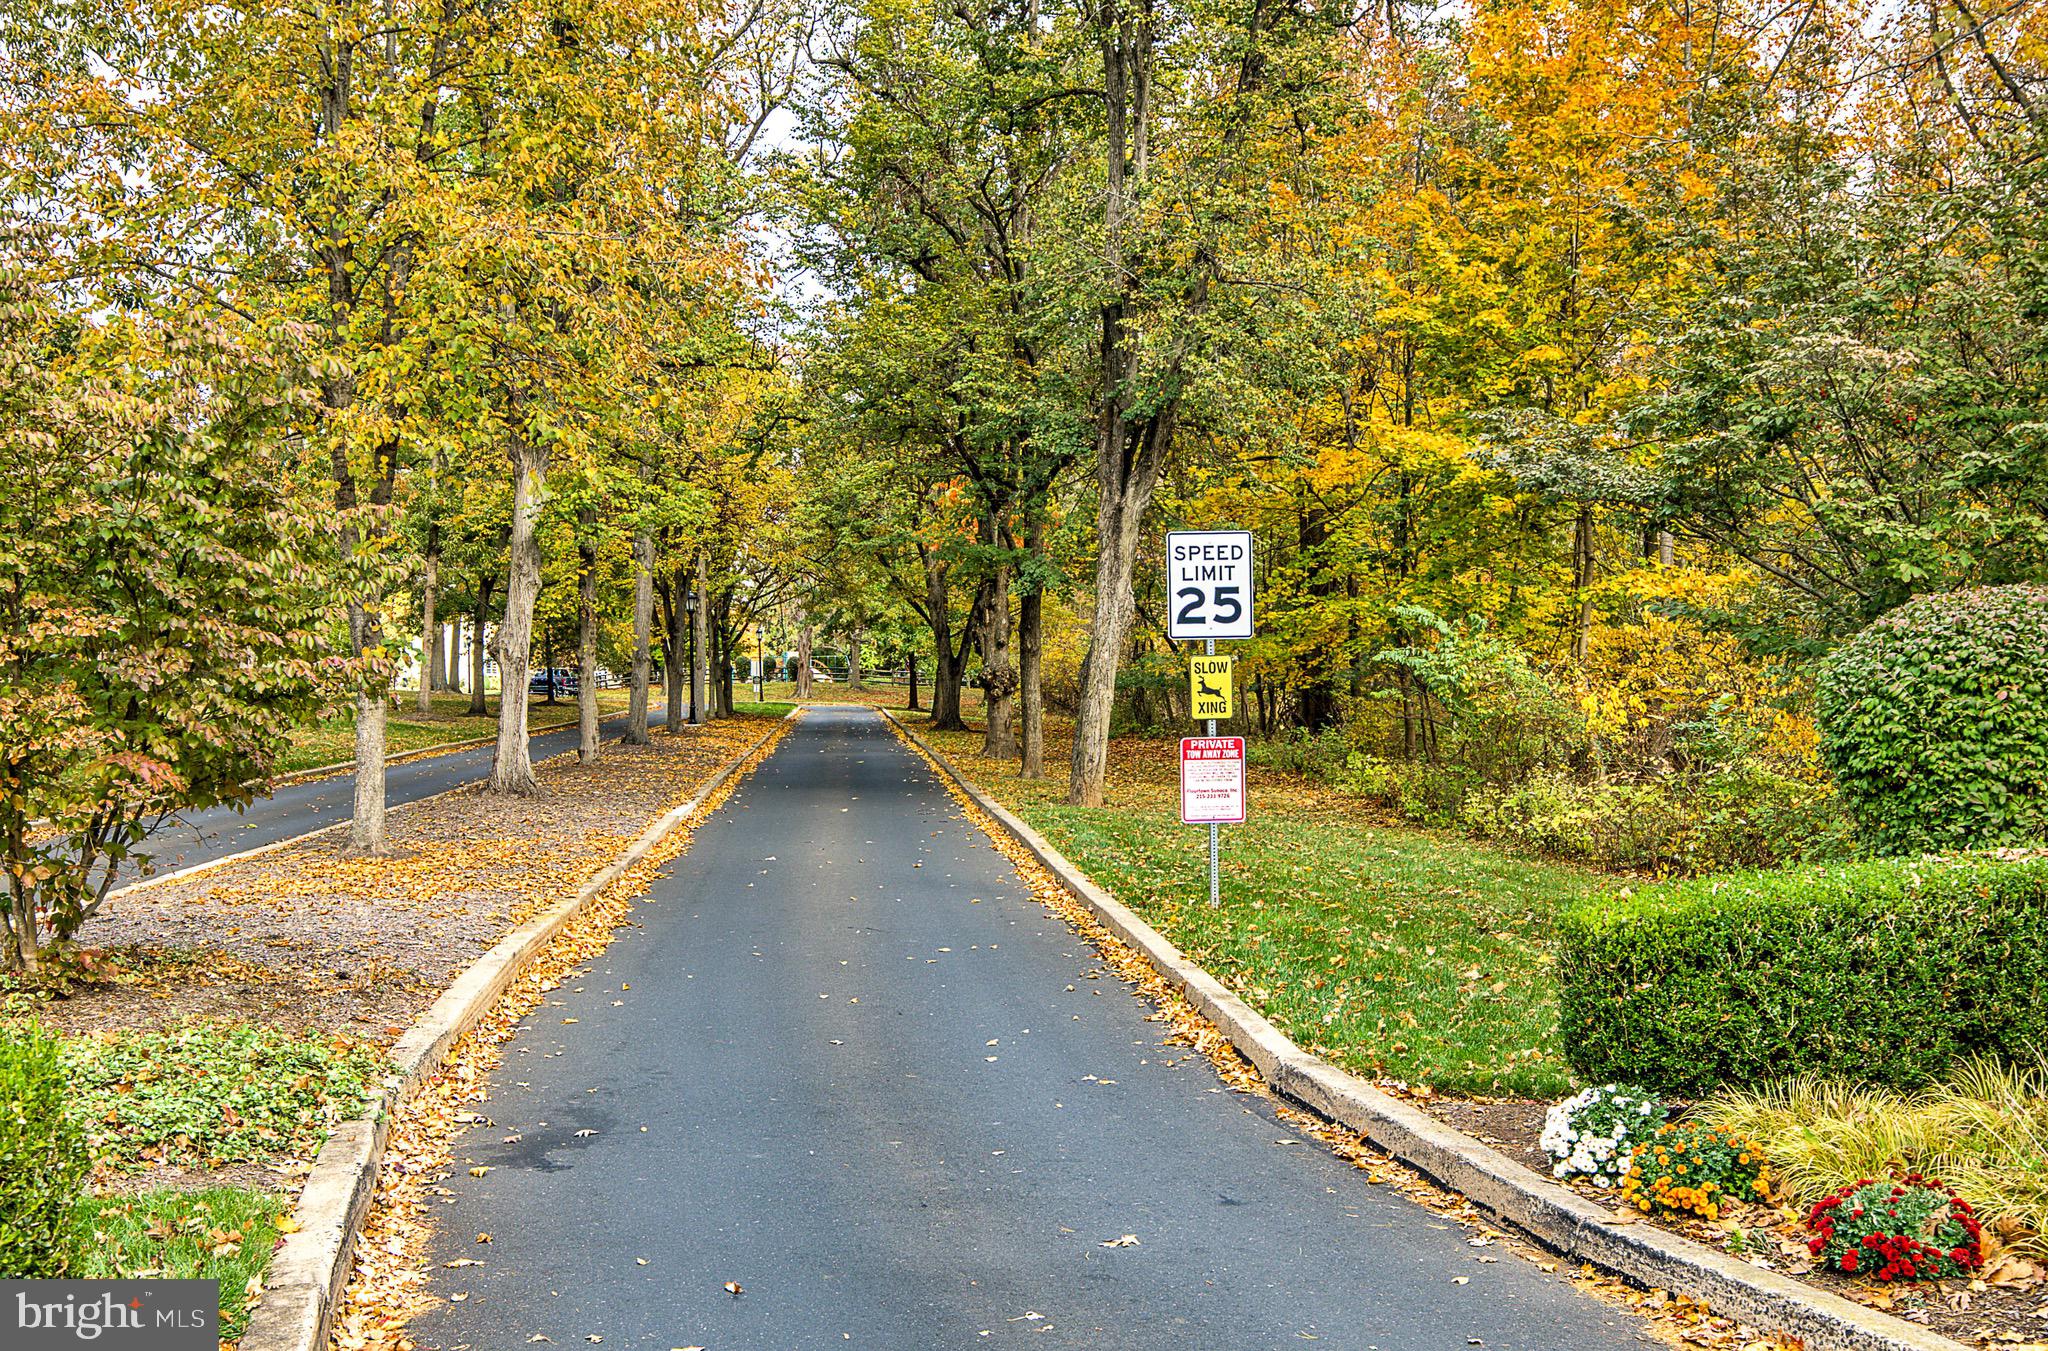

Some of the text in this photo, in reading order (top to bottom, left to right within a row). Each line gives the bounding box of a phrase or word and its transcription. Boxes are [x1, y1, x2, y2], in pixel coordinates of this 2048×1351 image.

[1174, 545, 1243, 561] SPEED
[1182, 565, 1235, 581] LIMIT
[1176, 586, 1242, 625] 25
[1194, 661, 1228, 674] SLOW
[1198, 701, 1227, 714] XING
[1190, 739, 1235, 749] PRIVATE
[1186, 749, 1239, 759] TOW AWAY ZONE
